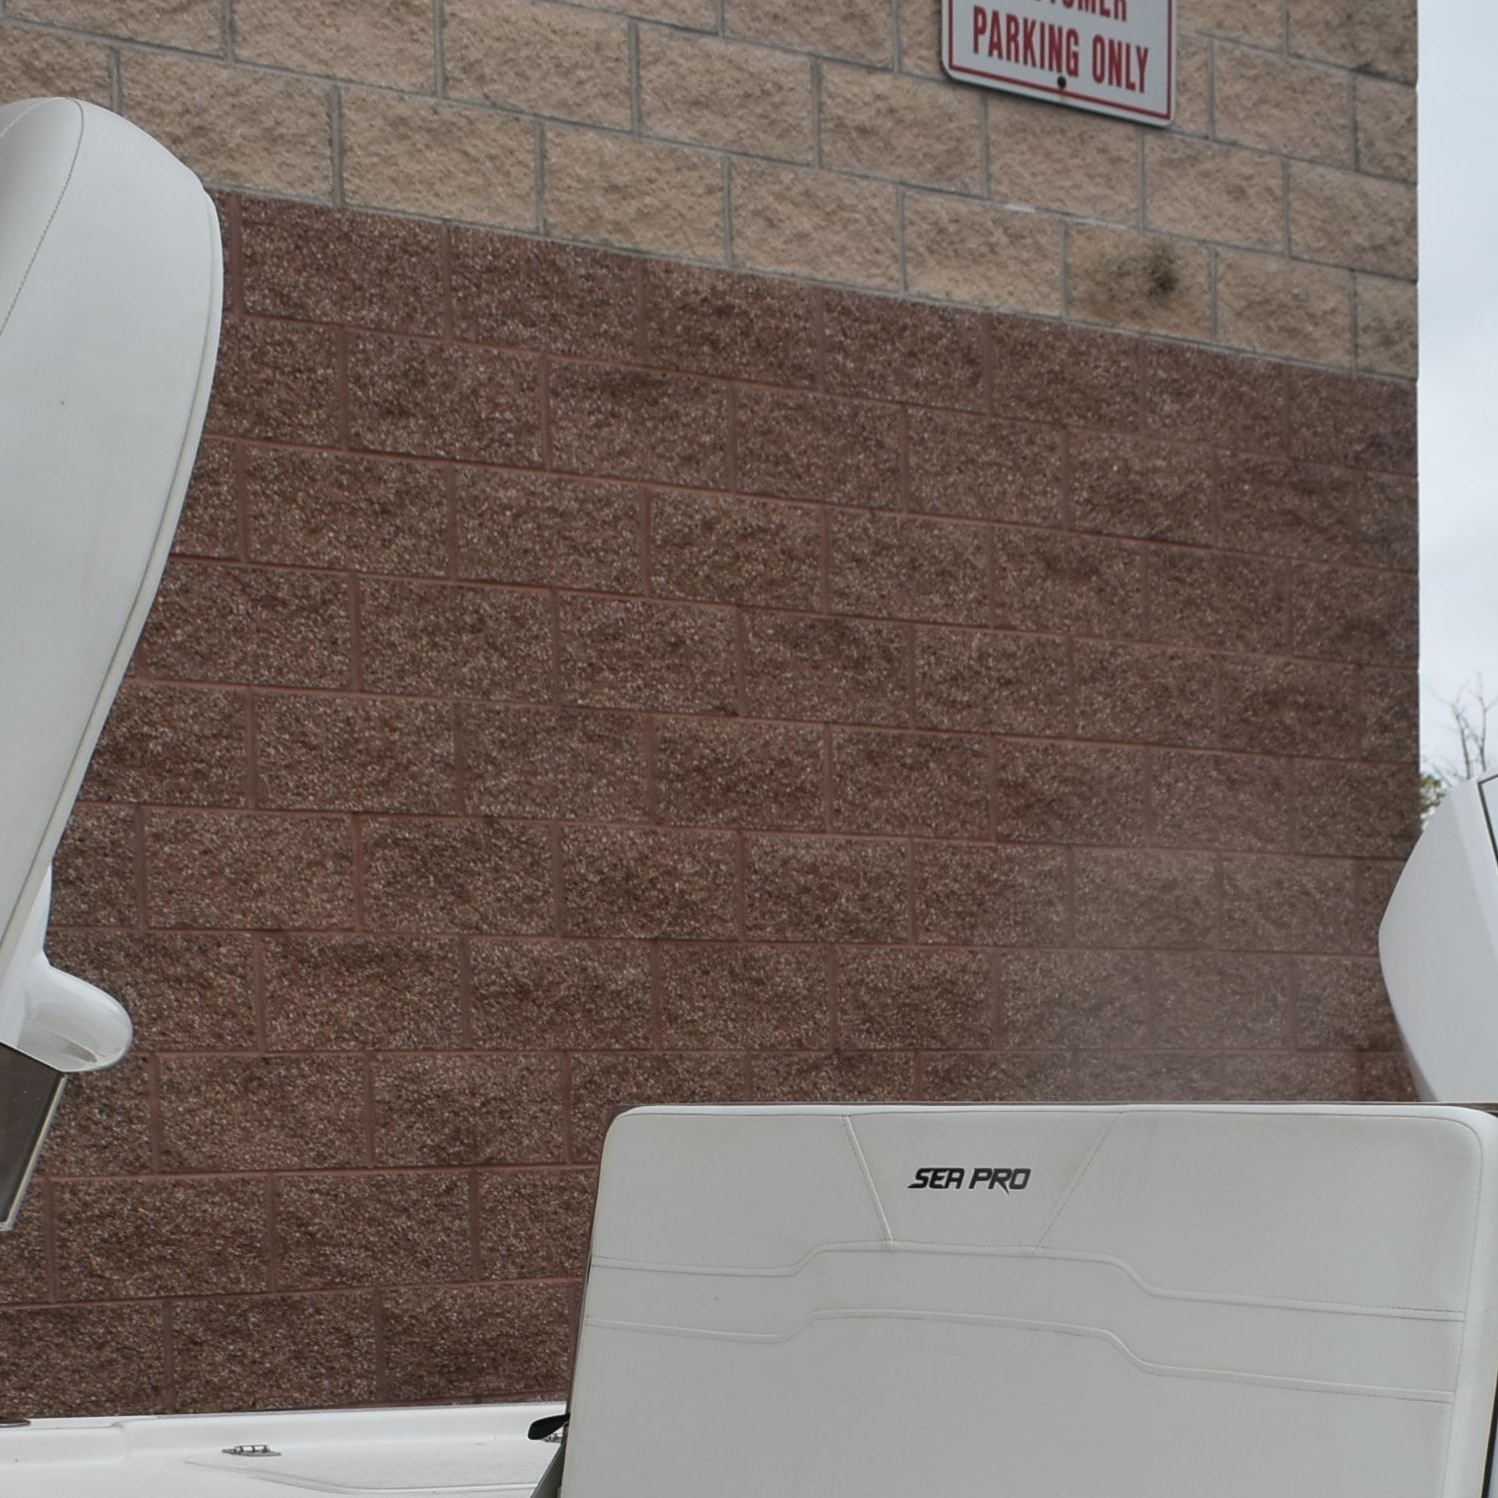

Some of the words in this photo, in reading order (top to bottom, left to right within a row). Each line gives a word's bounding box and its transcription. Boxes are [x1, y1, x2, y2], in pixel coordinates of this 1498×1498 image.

[972, 5, 1080, 78] PARKING
[1092, 34, 1149, 93] ONLY
[907, 1167, 965, 1189] SEA
[968, 1167, 1032, 1196] PRO
